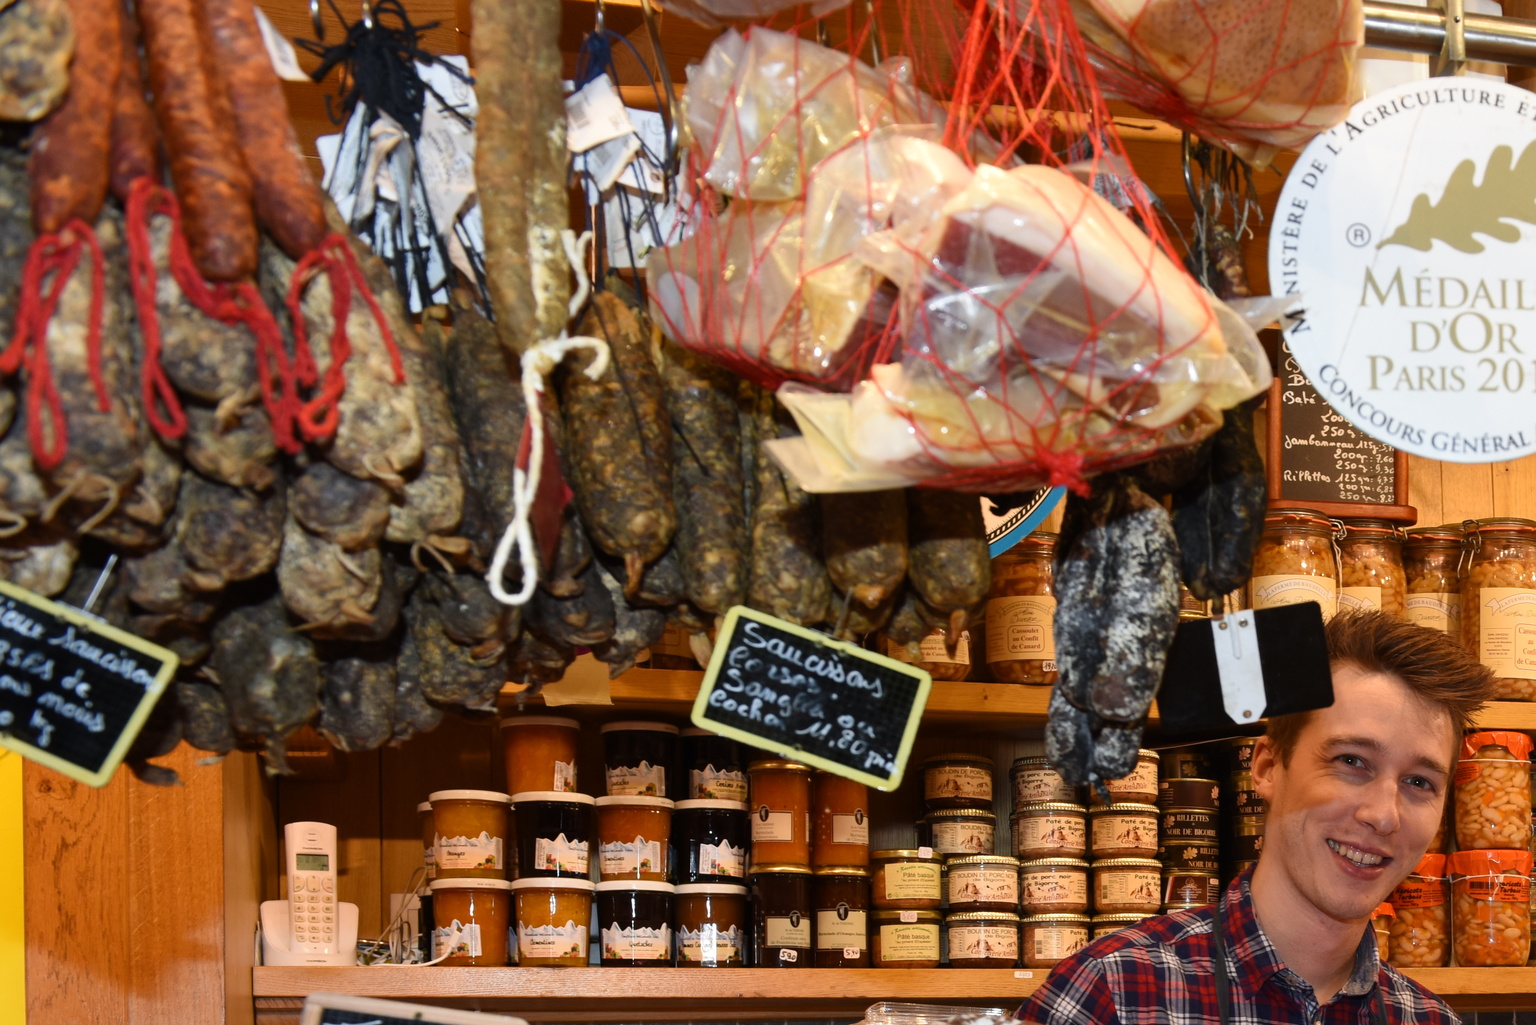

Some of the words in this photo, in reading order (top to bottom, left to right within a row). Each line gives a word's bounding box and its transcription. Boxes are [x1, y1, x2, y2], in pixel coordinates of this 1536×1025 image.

[1281, 195, 1312, 337] MNISTÈRE
[1301, 160, 1329, 191] DE
[1325, 86, 1507, 157] L'AGRICULTURE
[1409, 311, 1528, 356] D'OR
[1366, 354, 1466, 393] PARIS
[1317, 362, 1427, 448] CONCOURS
[1429, 429, 1533, 455] GÉNÉRAL
[1020, 635, 1039, 643] Confit
[1020, 642, 1041, 650] Canard
[1176, 814, 1209, 823] RILLETTES
[1166, 828, 1181, 836] NOIR
[1182, 828, 1193, 836] DE
